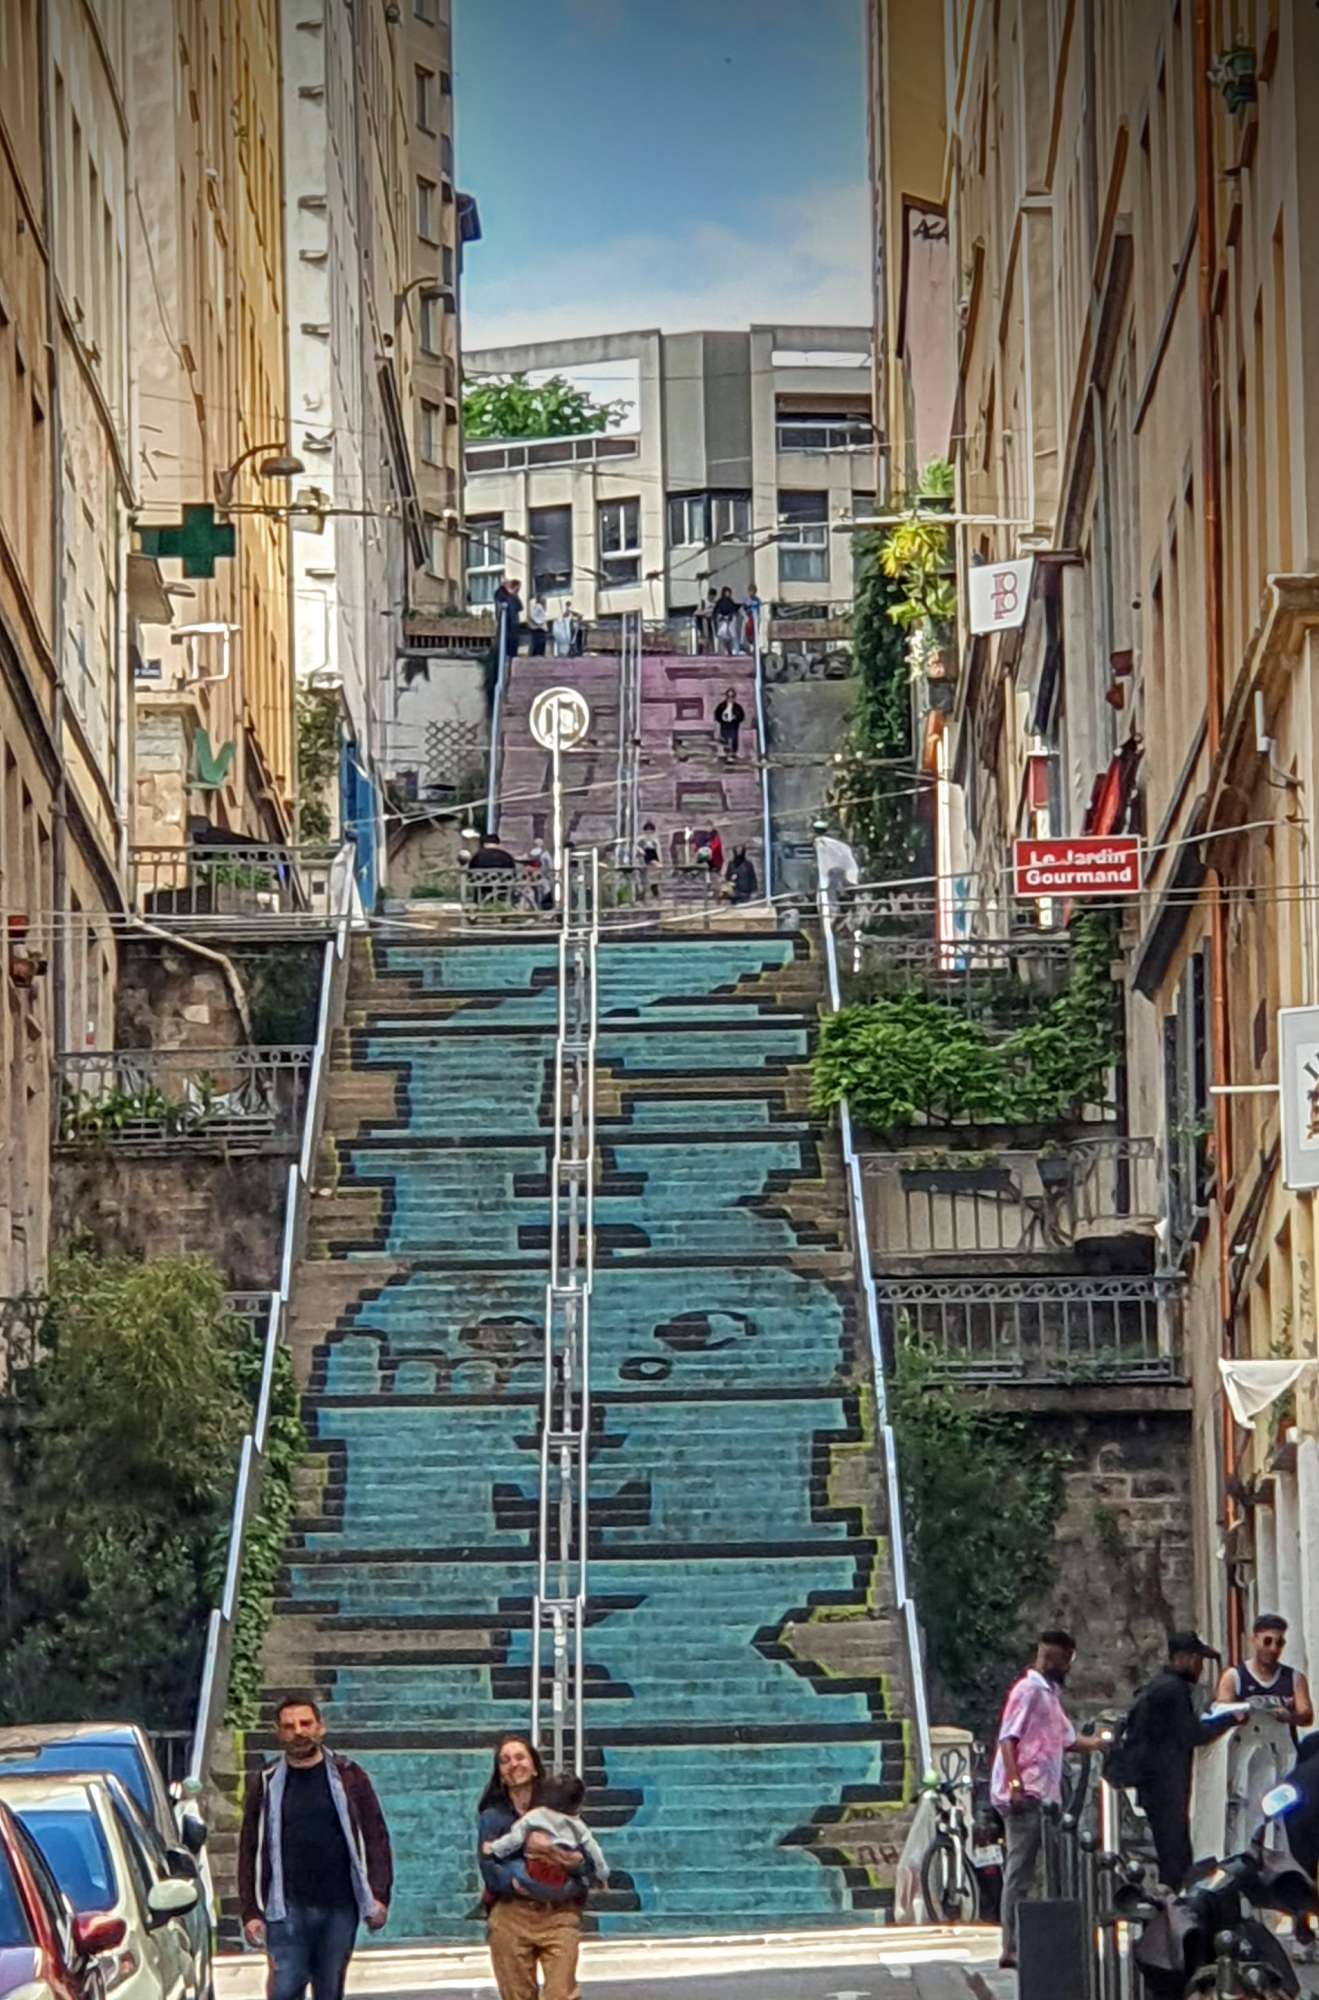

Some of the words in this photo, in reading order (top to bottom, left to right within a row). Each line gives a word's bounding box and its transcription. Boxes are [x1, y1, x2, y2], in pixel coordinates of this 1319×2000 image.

[1030, 850, 1056, 866] Le
[1064, 848, 1126, 866] Jardin
[1026, 866, 1132, 885] Gourmand
